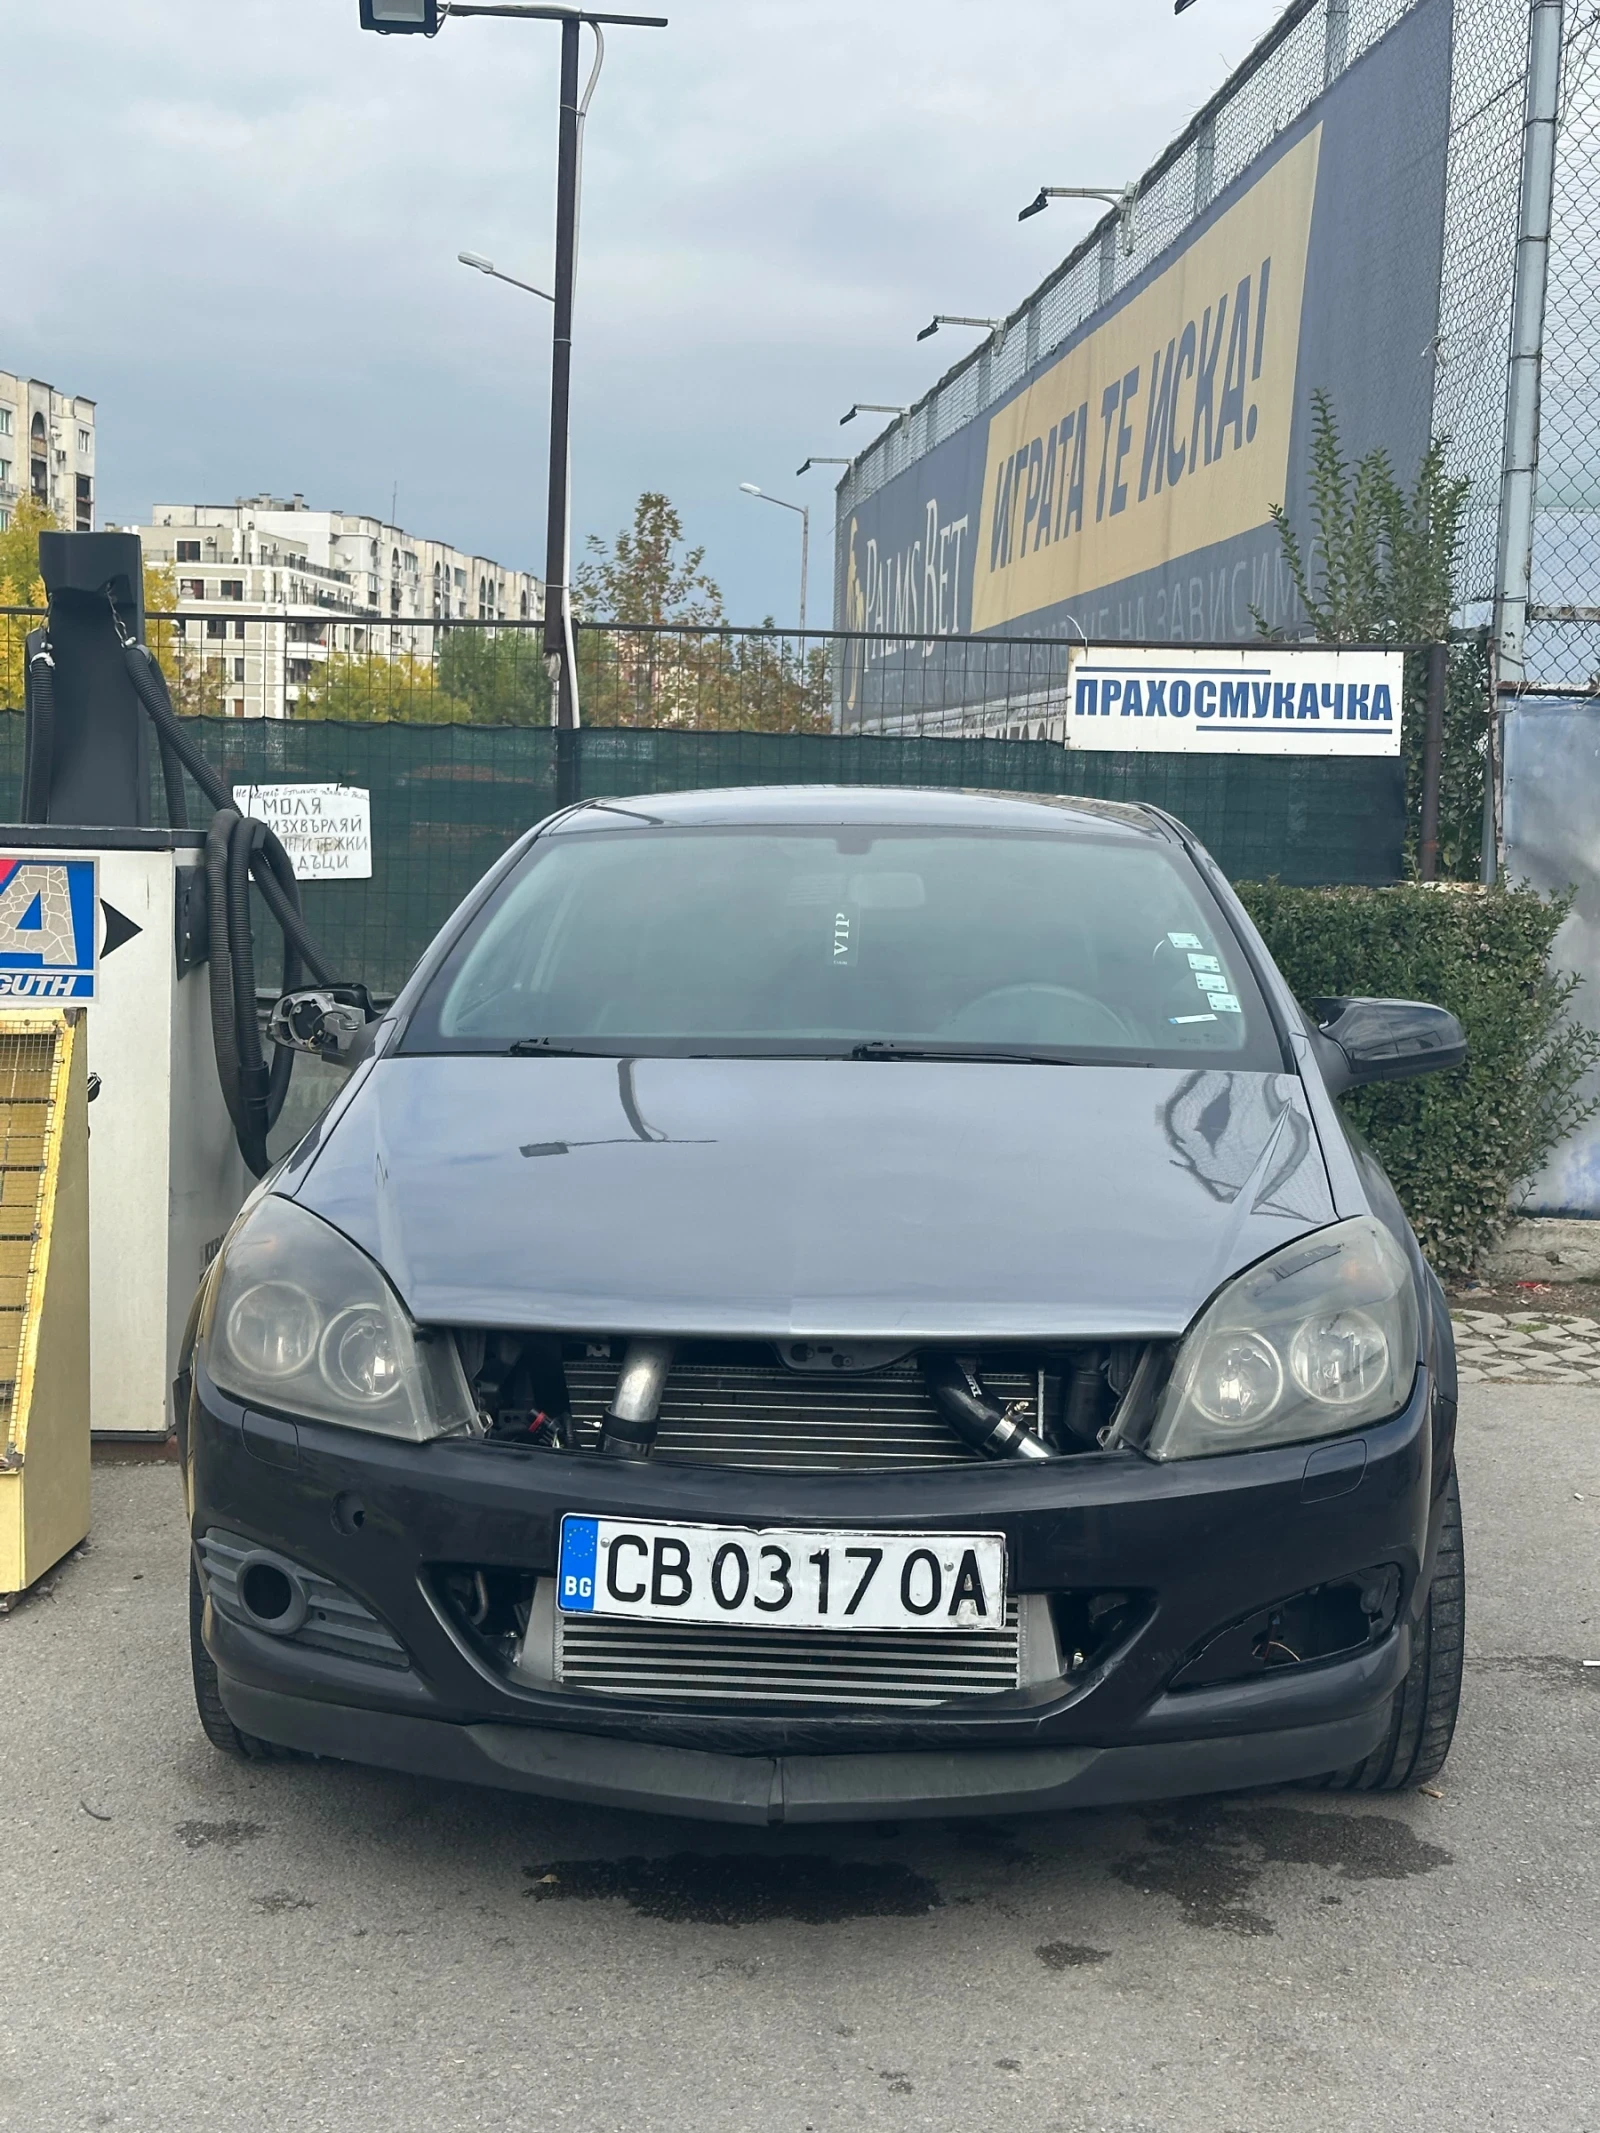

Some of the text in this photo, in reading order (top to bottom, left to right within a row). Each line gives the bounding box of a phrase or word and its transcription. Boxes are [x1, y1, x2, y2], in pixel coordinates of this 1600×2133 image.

[990, 256, 1271, 573] ИГРАТА ТЕ ИСКА!
[1075, 678, 1393, 720] ПРАХОСМУКАЧКА
[263, 797, 322, 816] МОЛЯ
[564, 1575, 592, 1598] BG
[607, 1534, 987, 1616] CB 0317 OA
